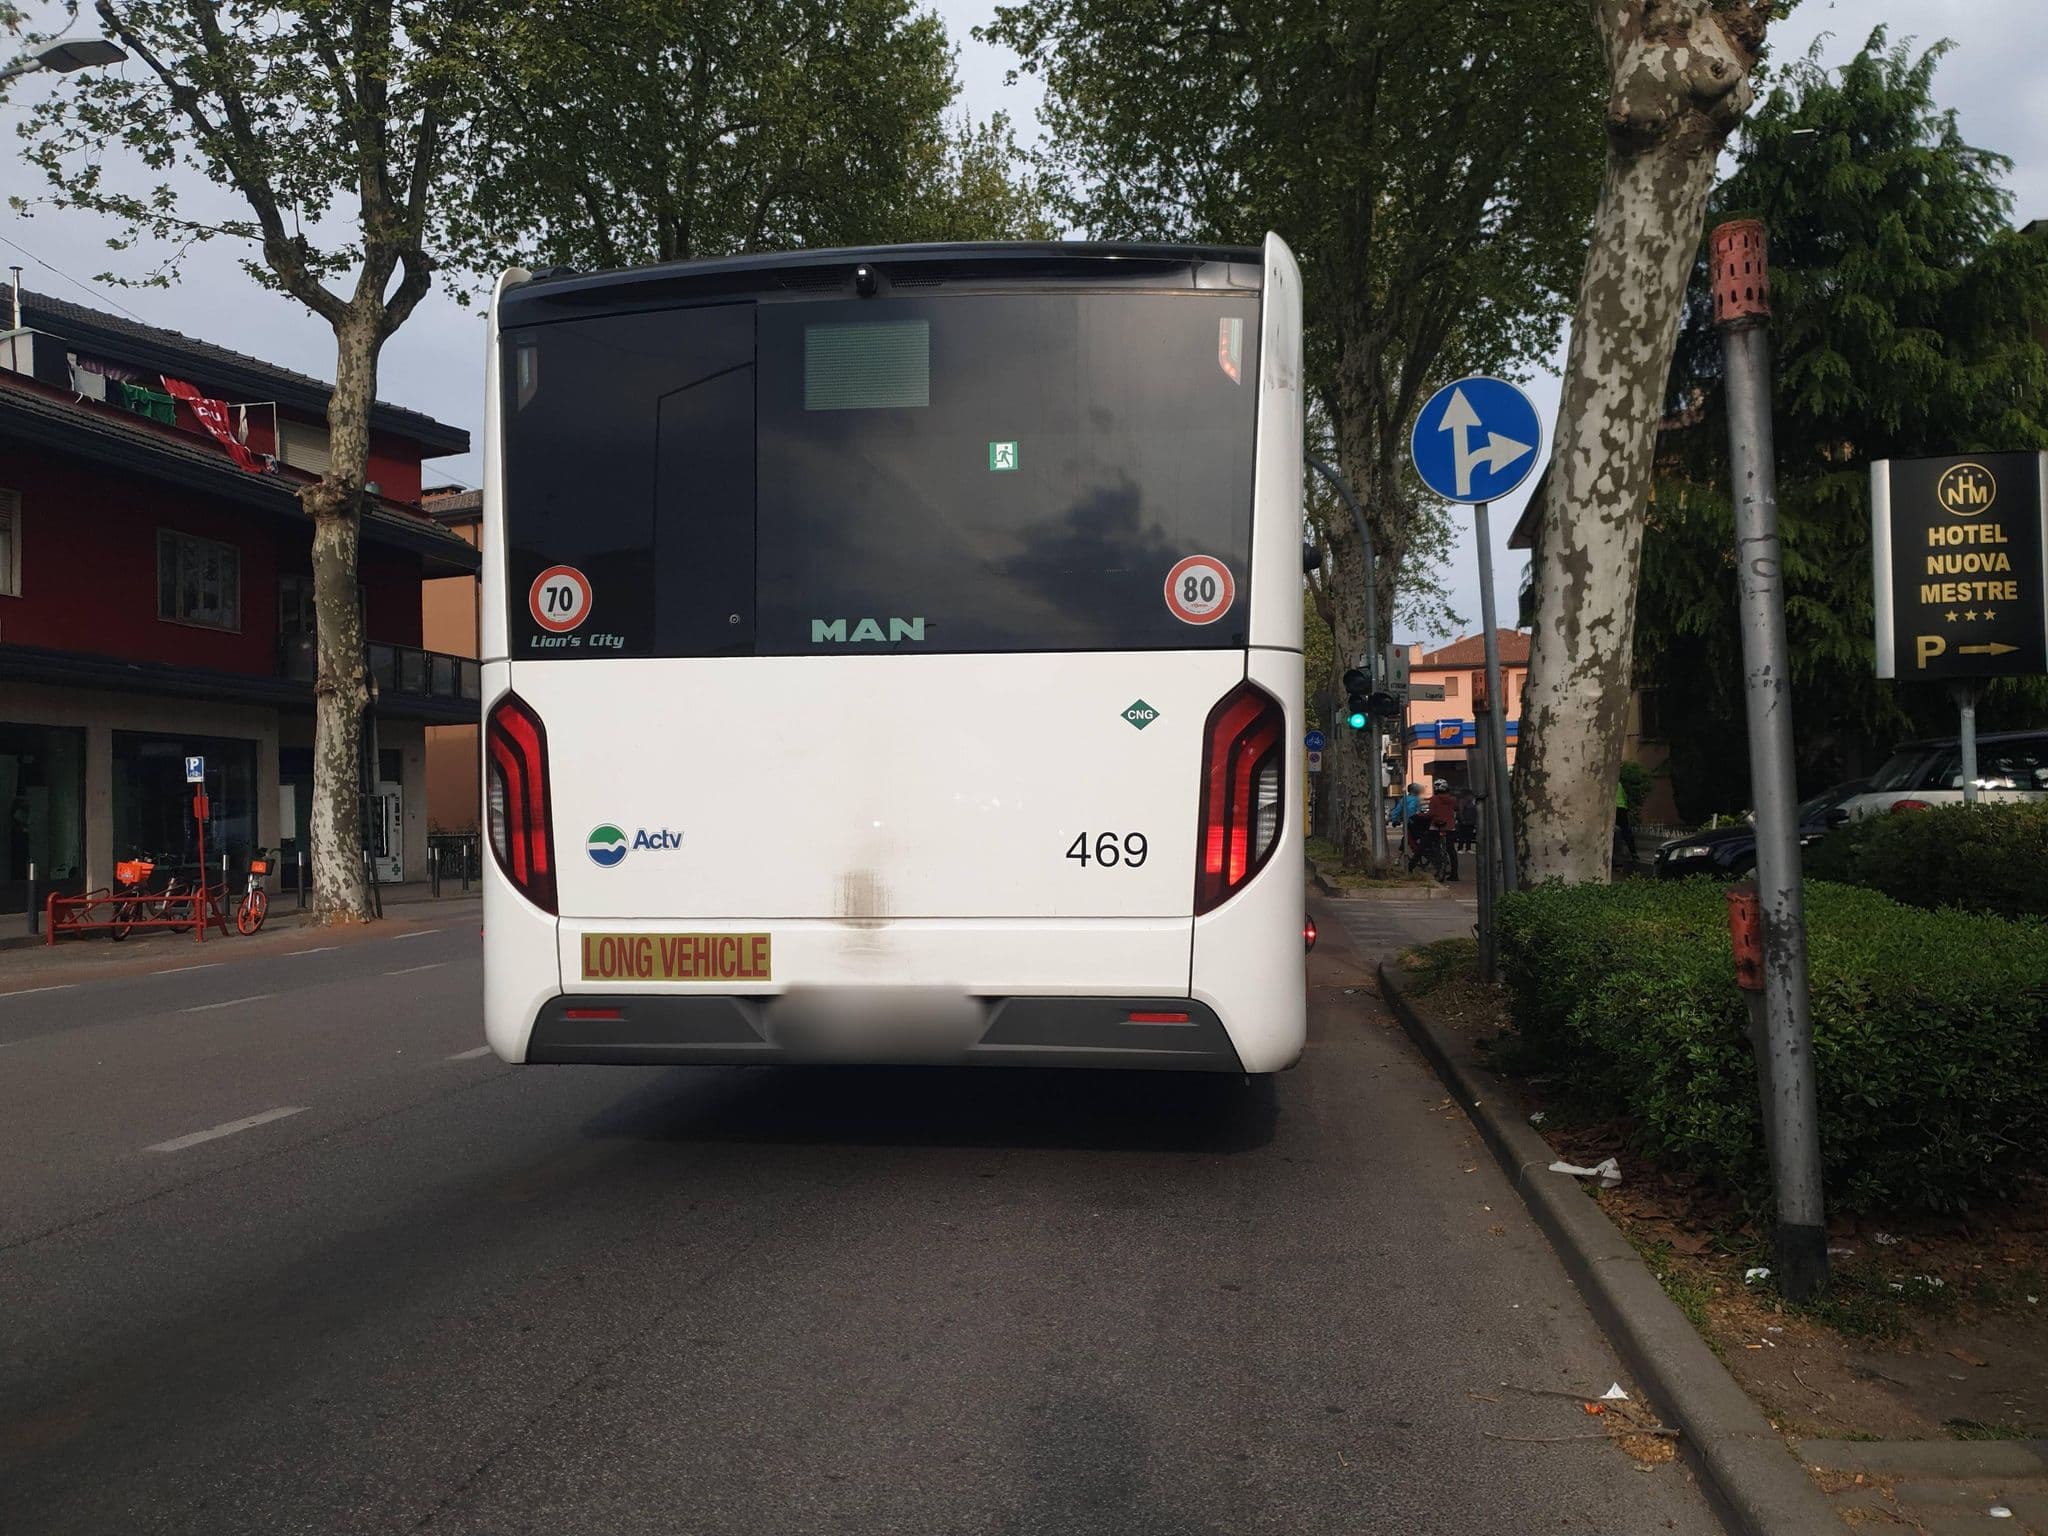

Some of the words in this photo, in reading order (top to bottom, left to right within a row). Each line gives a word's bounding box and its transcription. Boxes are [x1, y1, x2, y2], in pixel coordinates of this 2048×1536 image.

[1928, 524, 2008, 547] HOTEL
[1926, 552, 2012, 575] NUOVA
[546, 586, 574, 613] 70
[1183, 575, 1216, 603] 80
[1920, 580, 2018, 604] MESTRE
[530, 634, 582, 648] Lion's
[589, 633, 625, 649] City
[811, 617, 925, 643] MAN
[1916, 635, 1947, 669] P
[1127, 709, 1154, 720] CNG
[189, 758, 200, 770] P
[632, 829, 682, 850] Actv
[1065, 831, 1148, 868] 469
[584, 937, 653, 978] LONG
[659, 937, 768, 978] VEHICLE
